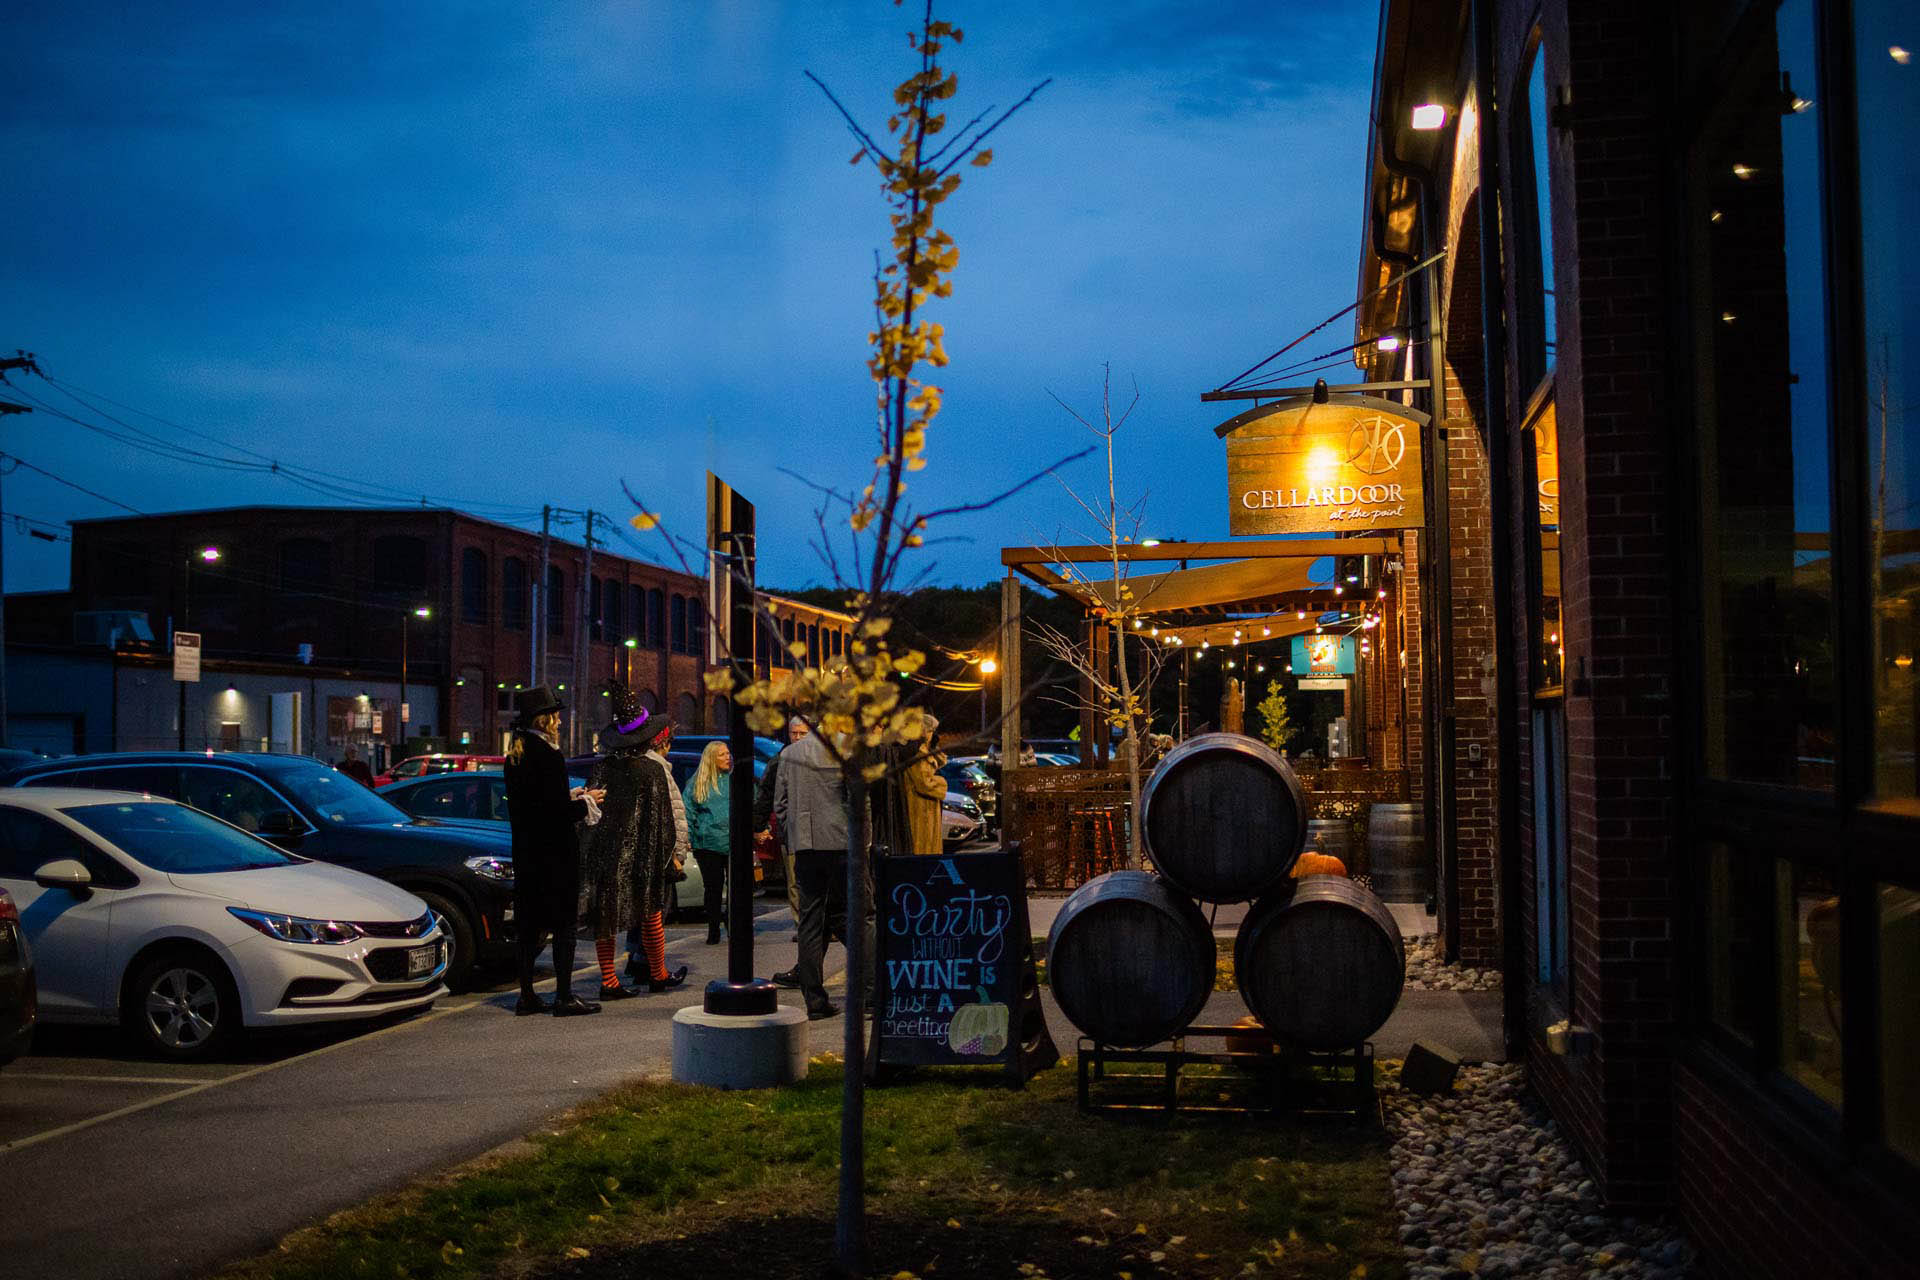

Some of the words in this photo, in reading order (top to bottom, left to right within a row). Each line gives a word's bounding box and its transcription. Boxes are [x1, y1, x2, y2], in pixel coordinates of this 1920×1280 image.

[1243, 484, 1404, 509] CELLARDOOR
[1329, 510, 1347, 521] at
[1347, 508, 1370, 521] the
[1369, 505, 1405, 524] point
[926, 859, 965, 885] A
[888, 883, 1011, 963] Party
[912, 936, 962, 960] WITHOUT
[886, 958, 973, 990] WINE
[887, 991, 933, 1018] just
[937, 993, 954, 1013] A
[880, 1015, 951, 1046] meeting
